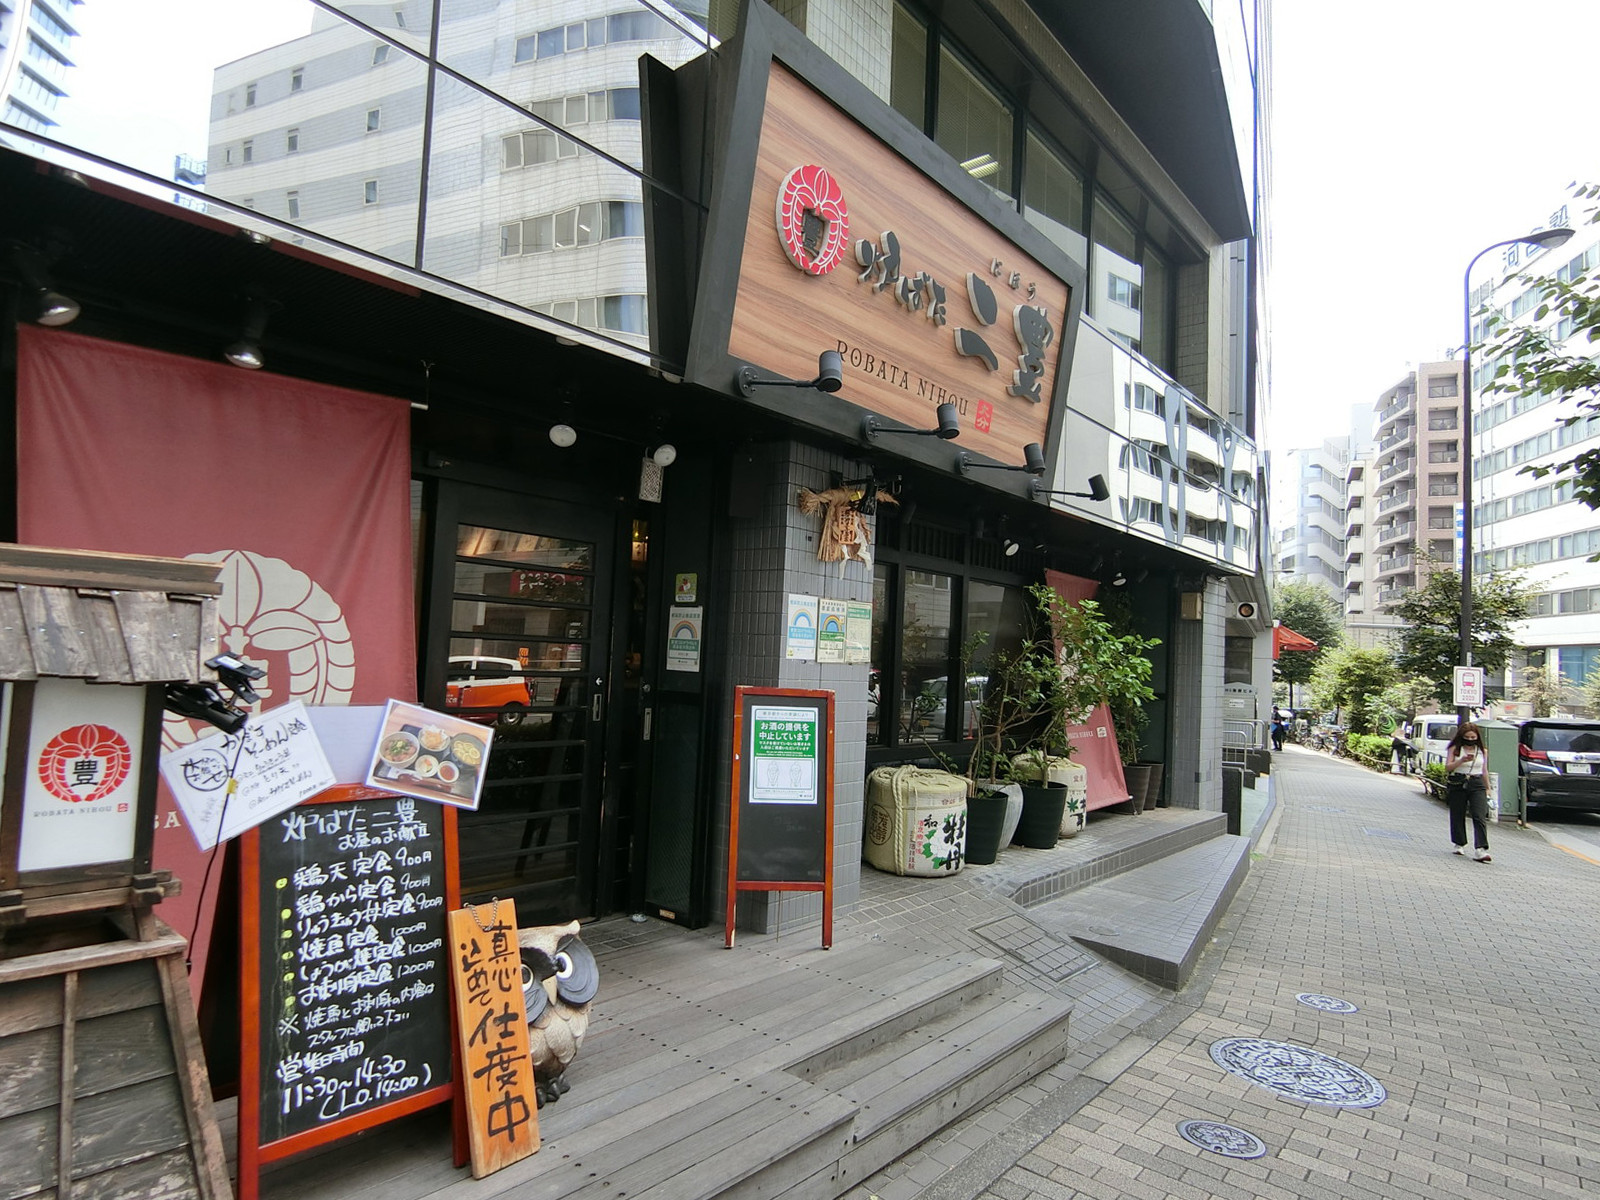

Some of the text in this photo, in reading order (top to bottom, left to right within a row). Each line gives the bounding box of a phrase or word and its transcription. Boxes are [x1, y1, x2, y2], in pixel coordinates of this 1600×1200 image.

[836, 339, 969, 416] ROBATA NIHOU
[758, 731, 811, 741] 中止しています
[760, 722, 810, 732] お酒の提供を
[70, 759, 99, 787] 豊
[461, 938, 493, 1006] 込めて
[483, 920, 517, 993] 真心
[469, 1002, 531, 1143] 仕度中
